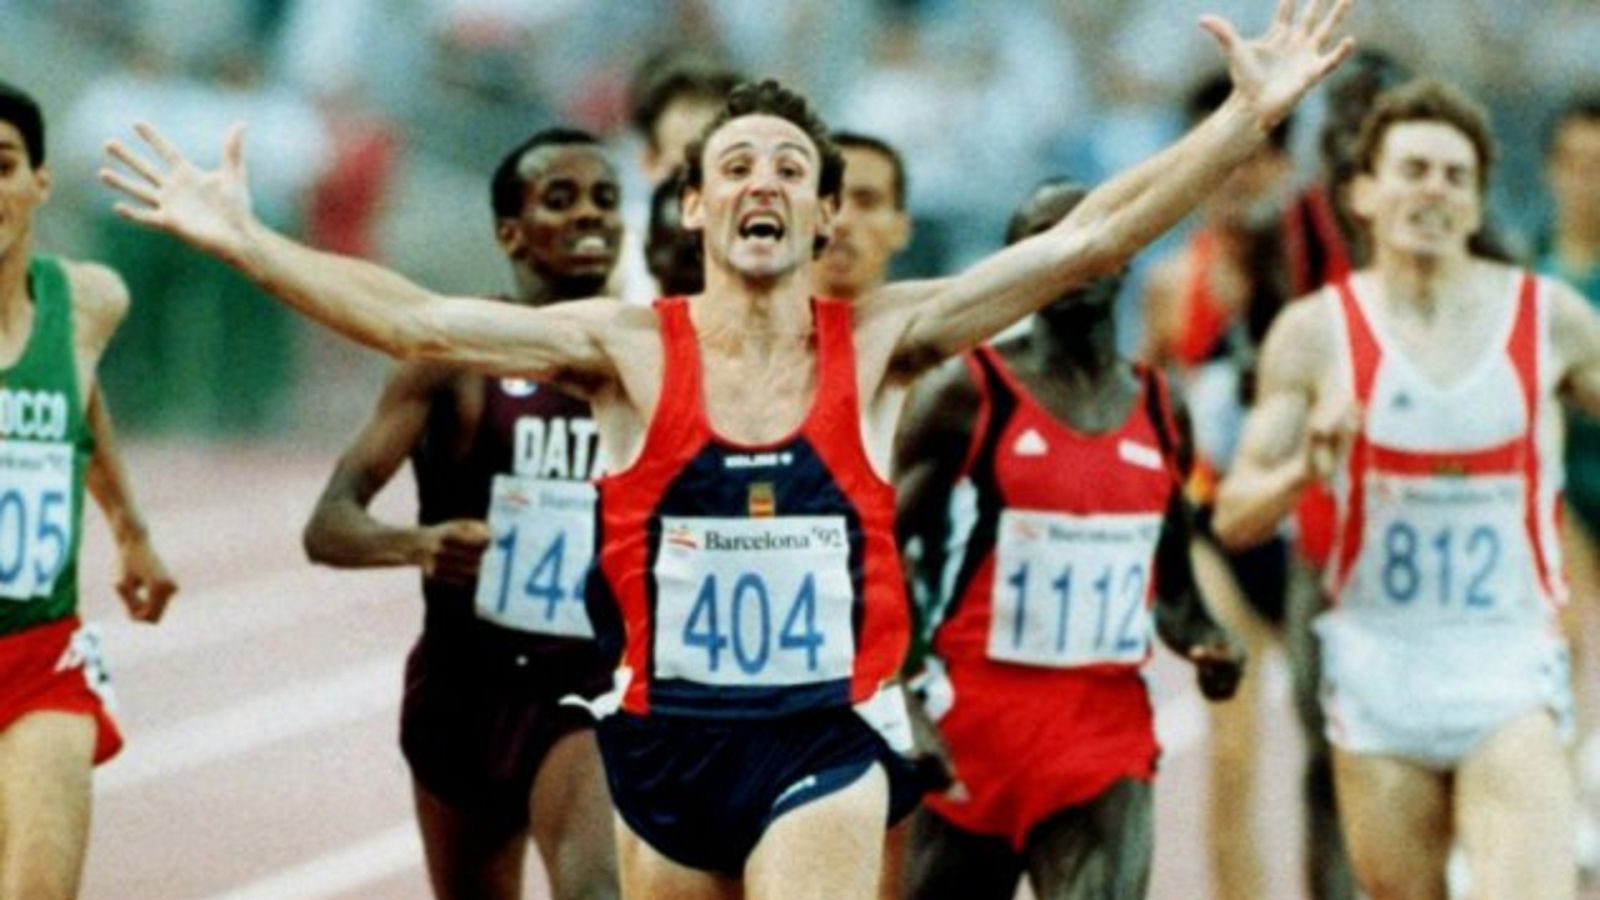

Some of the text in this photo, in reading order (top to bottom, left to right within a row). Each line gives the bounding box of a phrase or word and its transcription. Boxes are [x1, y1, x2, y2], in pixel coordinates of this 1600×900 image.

[0, 490, 66, 584] 05
[495, 526, 587, 621] 14
[705, 526, 843, 550] Barcelona '92
[1382, 522, 1501, 606] 812
[682, 572, 825, 675] 404
[1007, 561, 1144, 652] 1112
